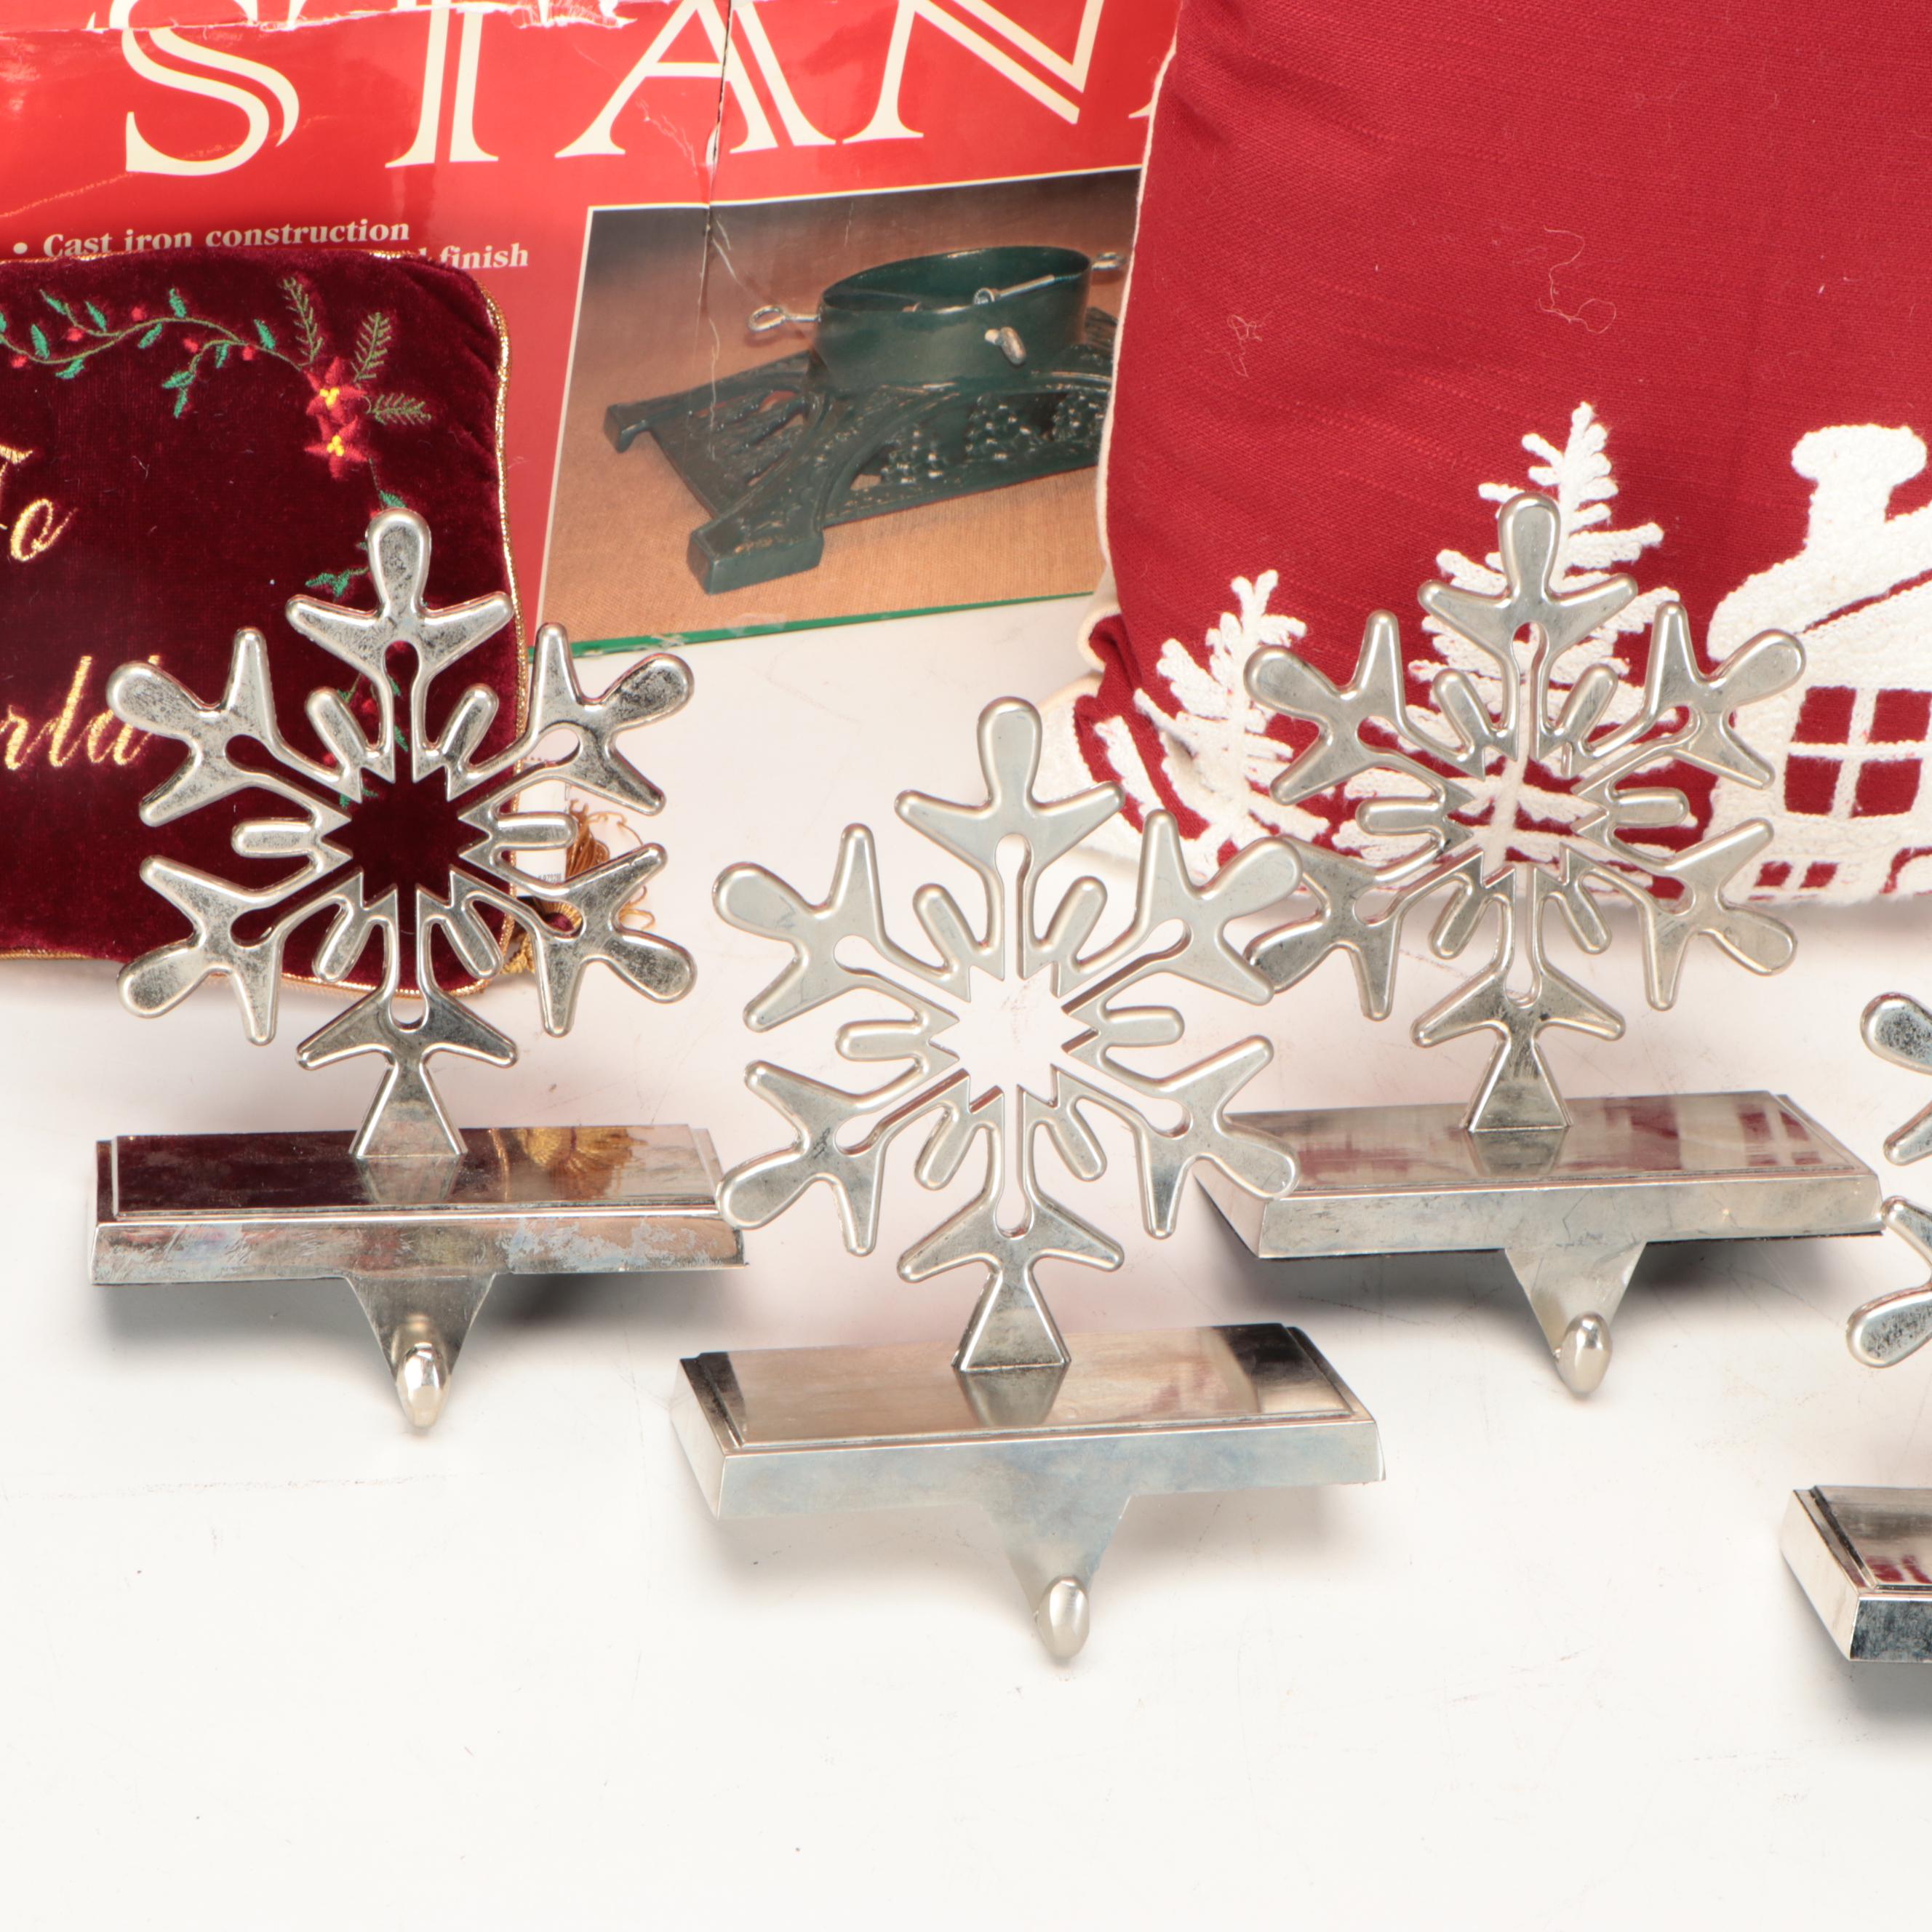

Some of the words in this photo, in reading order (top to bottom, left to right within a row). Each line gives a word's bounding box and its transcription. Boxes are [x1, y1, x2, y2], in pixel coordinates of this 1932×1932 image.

[109, 0, 1155, 177] STAN
[44, 233, 112, 257] Cast
[125, 229, 192, 253] iron
[206, 219, 410, 248] construction
[439, 242, 529, 270] finish
